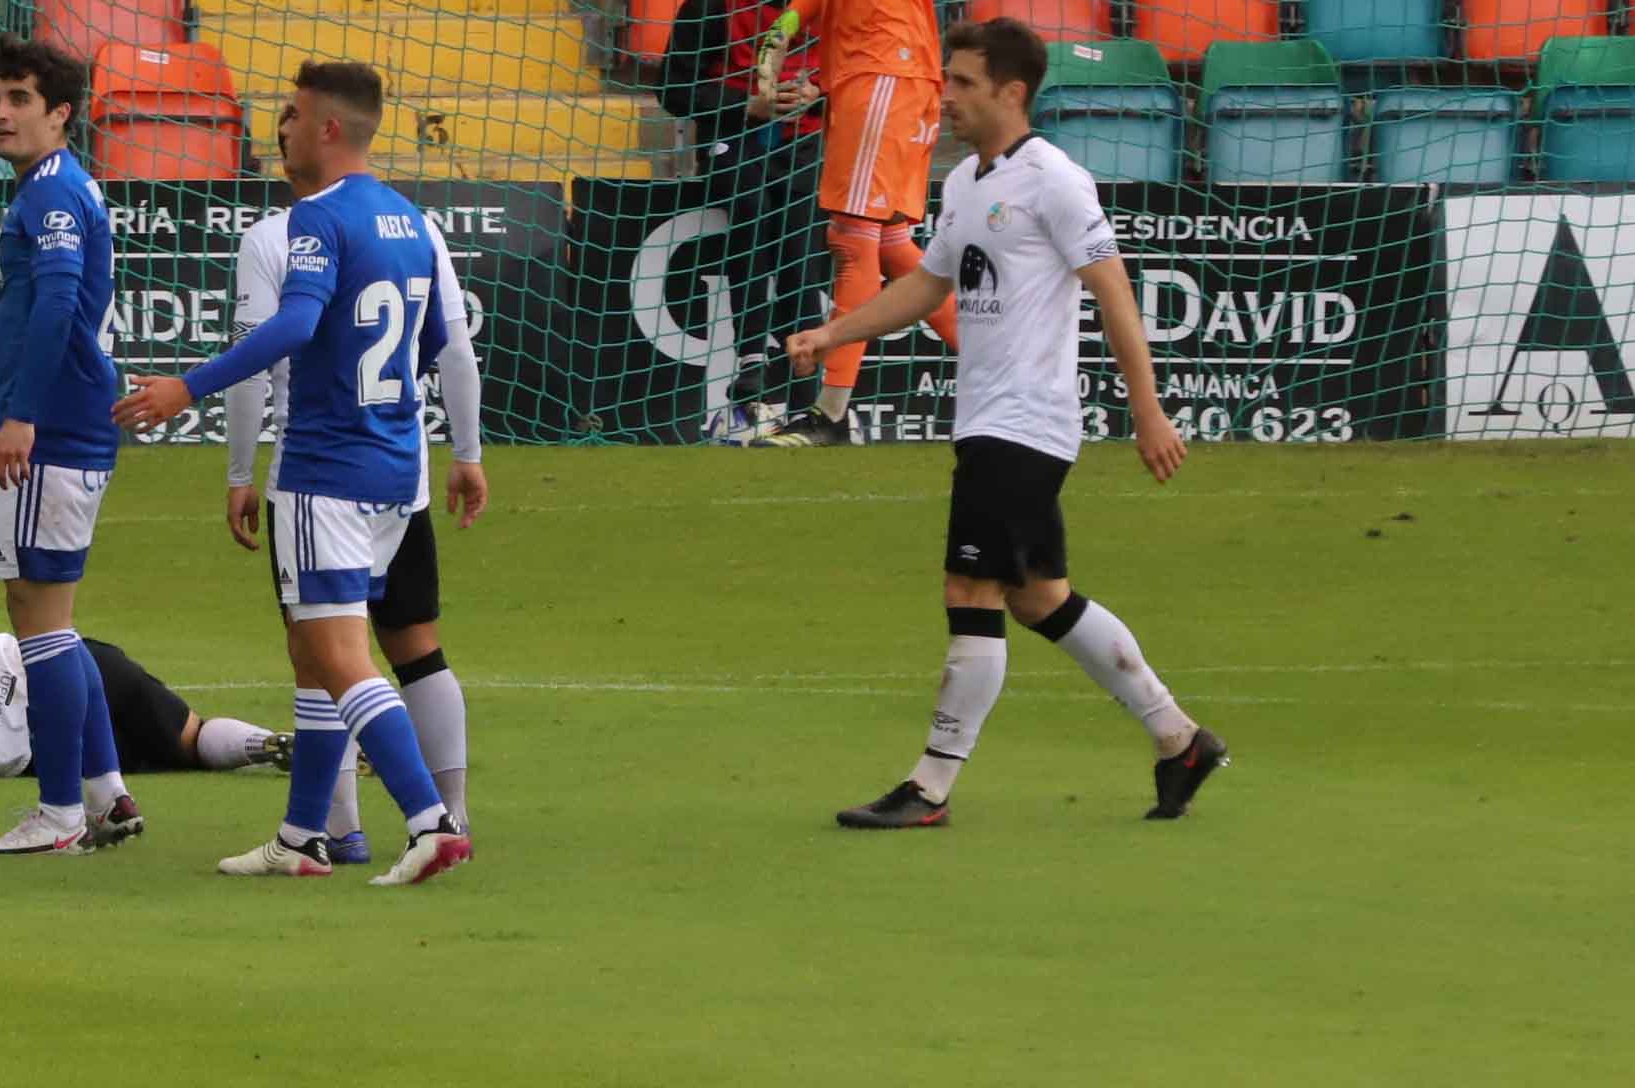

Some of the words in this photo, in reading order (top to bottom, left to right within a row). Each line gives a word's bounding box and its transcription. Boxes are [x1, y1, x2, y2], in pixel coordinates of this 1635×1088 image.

[37, 231, 80, 246] HYUNDAI
[1114, 215, 1313, 242] ESIDENCIA
[1142, 269, 1357, 344] DAVID
[1468, 214, 1635, 416] A
[354, 277, 432, 407] 27
[1251, 406, 1354, 443] 623
